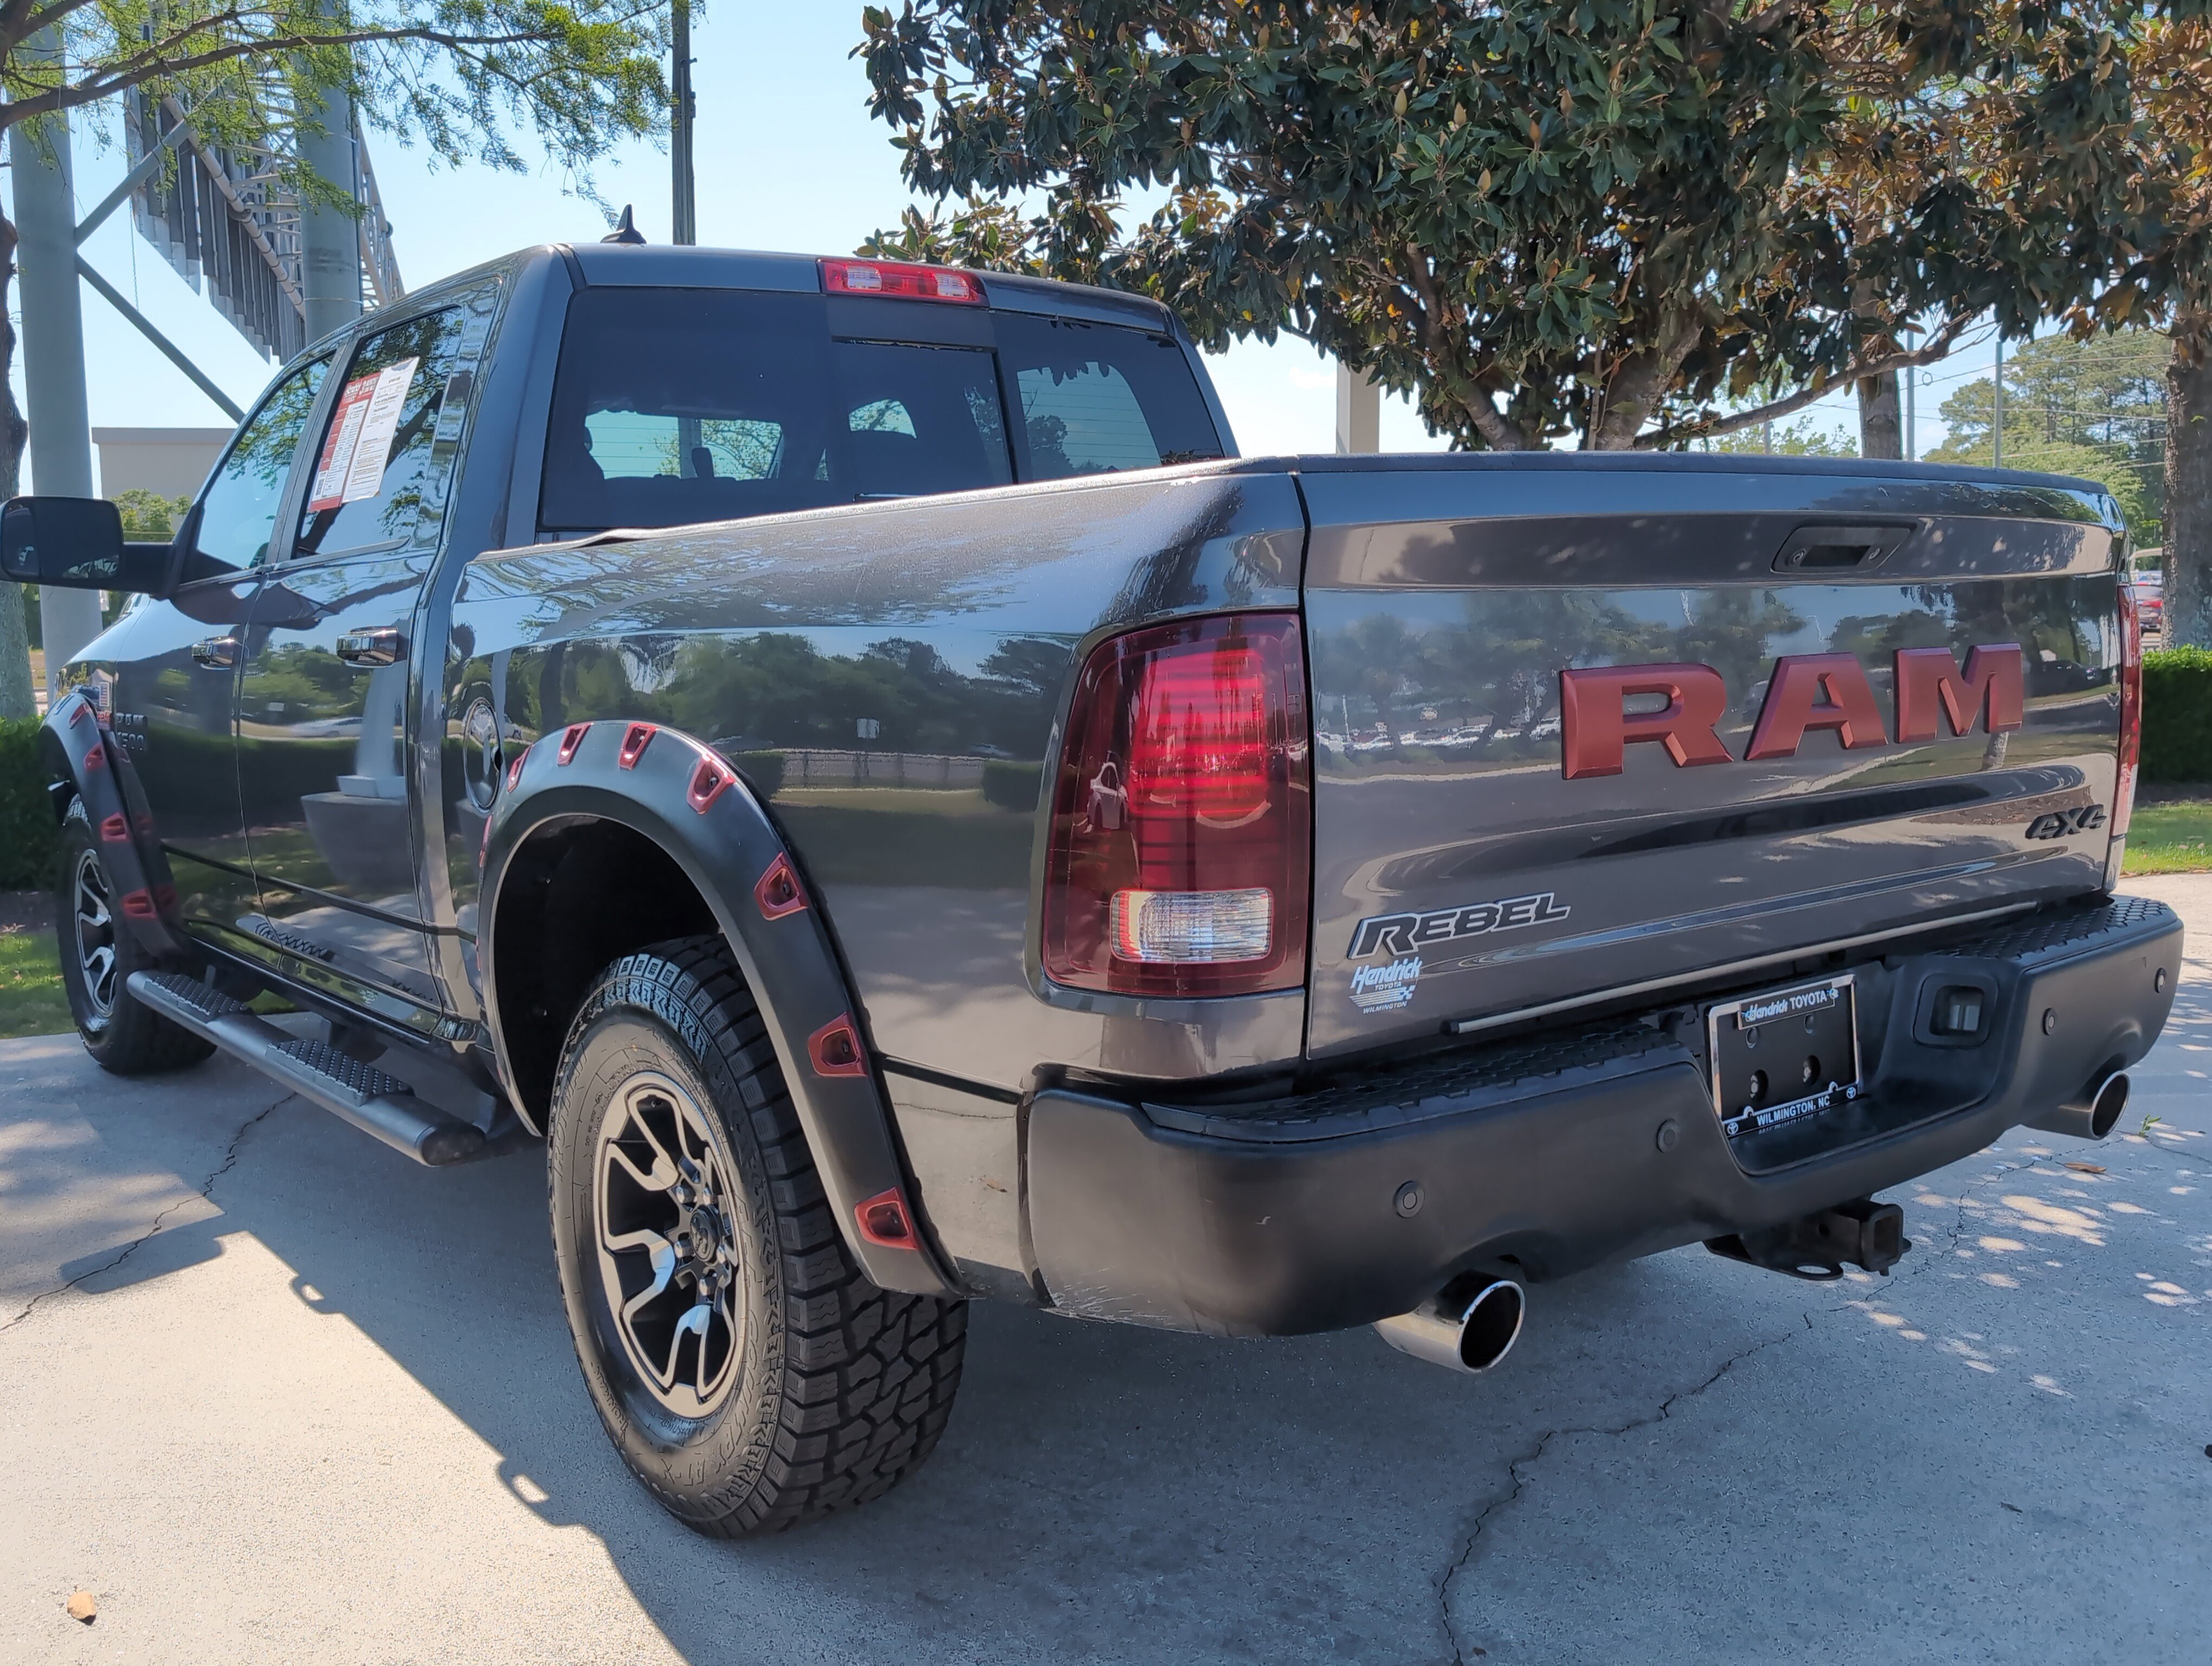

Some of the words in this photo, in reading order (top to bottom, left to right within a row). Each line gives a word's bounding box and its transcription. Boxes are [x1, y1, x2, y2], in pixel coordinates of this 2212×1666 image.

[1560, 642, 2024, 780] RAM
[1346, 891, 1572, 959] REBEL
[1349, 957, 1423, 994] Hendrick
[1374, 981, 1402, 992] TOYOTA
[1362, 1001, 1407, 1015] WILMINGTON
[1789, 990, 1828, 1010] TOYOTA
[1757, 1100, 1816, 1126] WILMINGTON,
[1818, 1095, 1830, 1110] NC
